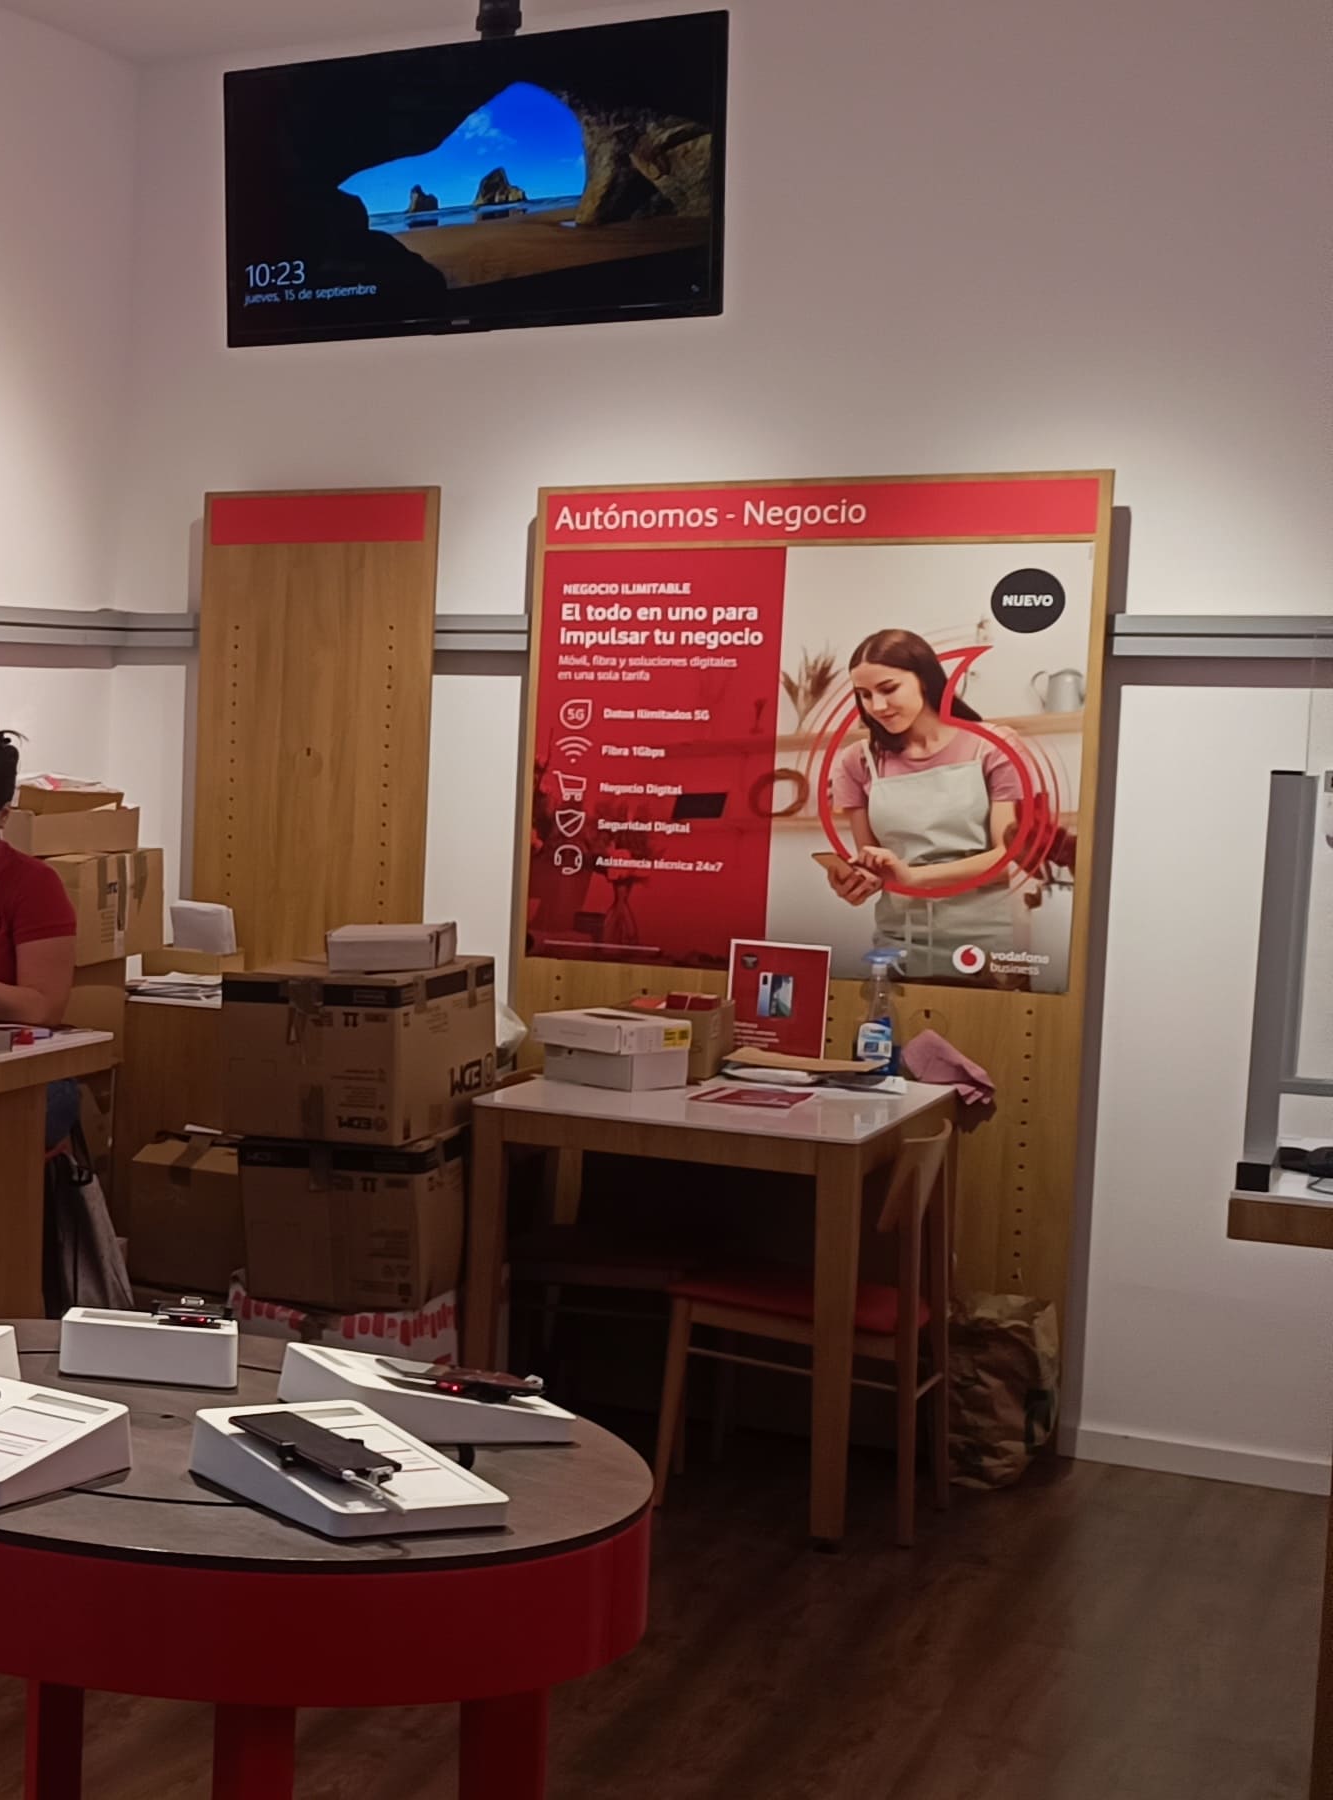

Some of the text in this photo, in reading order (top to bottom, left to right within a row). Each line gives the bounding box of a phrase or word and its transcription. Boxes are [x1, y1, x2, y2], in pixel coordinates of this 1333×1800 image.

[245, 261, 305, 287] 10:23
[285, 289, 295, 300] 15
[298, 288, 312, 300] de
[315, 283, 377, 299] septiembre
[554, 503, 718, 531] Autónomos
[744, 500, 867, 532] Negocio
[563, 582, 691, 595] NEGOCIO ILIMITABLE
[1001, 593, 1054, 607] NUEVO
[561, 603, 759, 625] El todo en uno para
[560, 627, 764, 650] impulsar tu negocio
[592, 655, 618, 667] fibra
[619, 658, 626, 668] y
[628, 656, 688, 667] soluciones
[690, 656, 738, 669] digitales
[558, 670, 651, 681] en una sola tarifa
[567, 707, 584, 721] 5G
[694, 709, 710, 721] 5G
[601, 745, 666, 758] Fibra 1Gbps
[599, 783, 682, 797] Negocio Digital
[598, 819, 690, 834] Seguridad Digital
[595, 856, 724, 872] Asistencia técnica 24x7
[989, 962, 1040, 975] business
